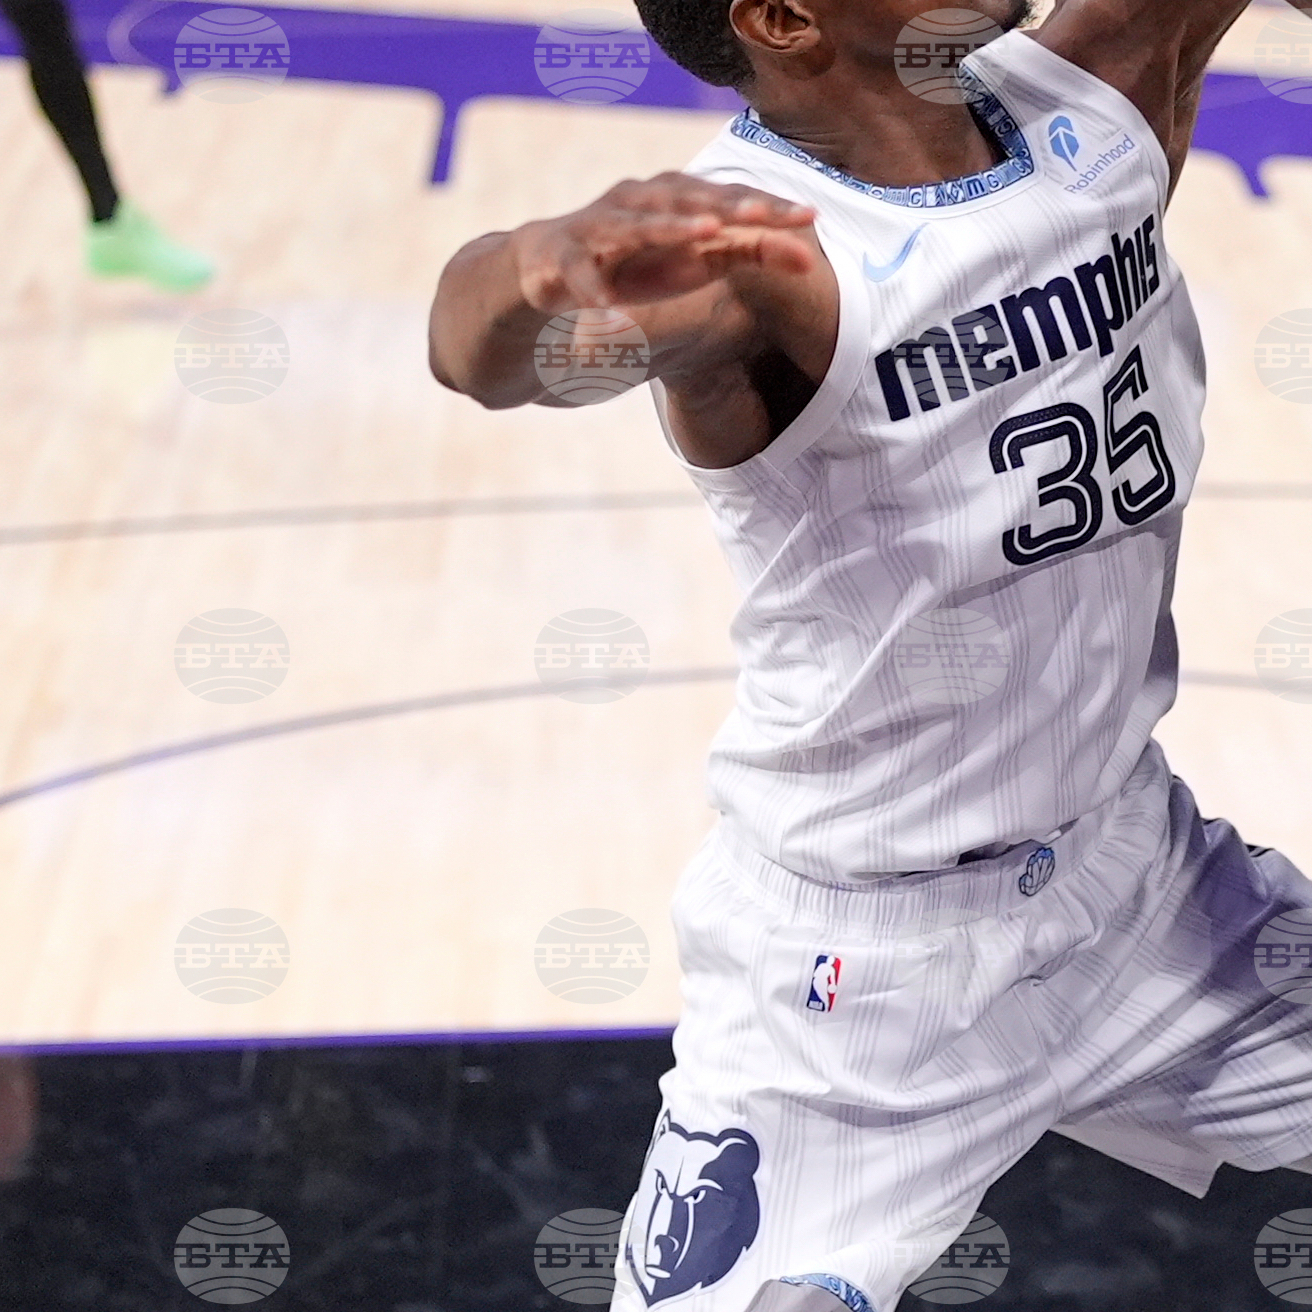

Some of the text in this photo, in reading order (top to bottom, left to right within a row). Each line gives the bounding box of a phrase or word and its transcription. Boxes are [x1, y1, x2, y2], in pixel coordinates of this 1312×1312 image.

[1065, 132, 1136, 195] Robinhood
[874, 213, 1160, 422] memphis
[989, 343, 1176, 566] 35
